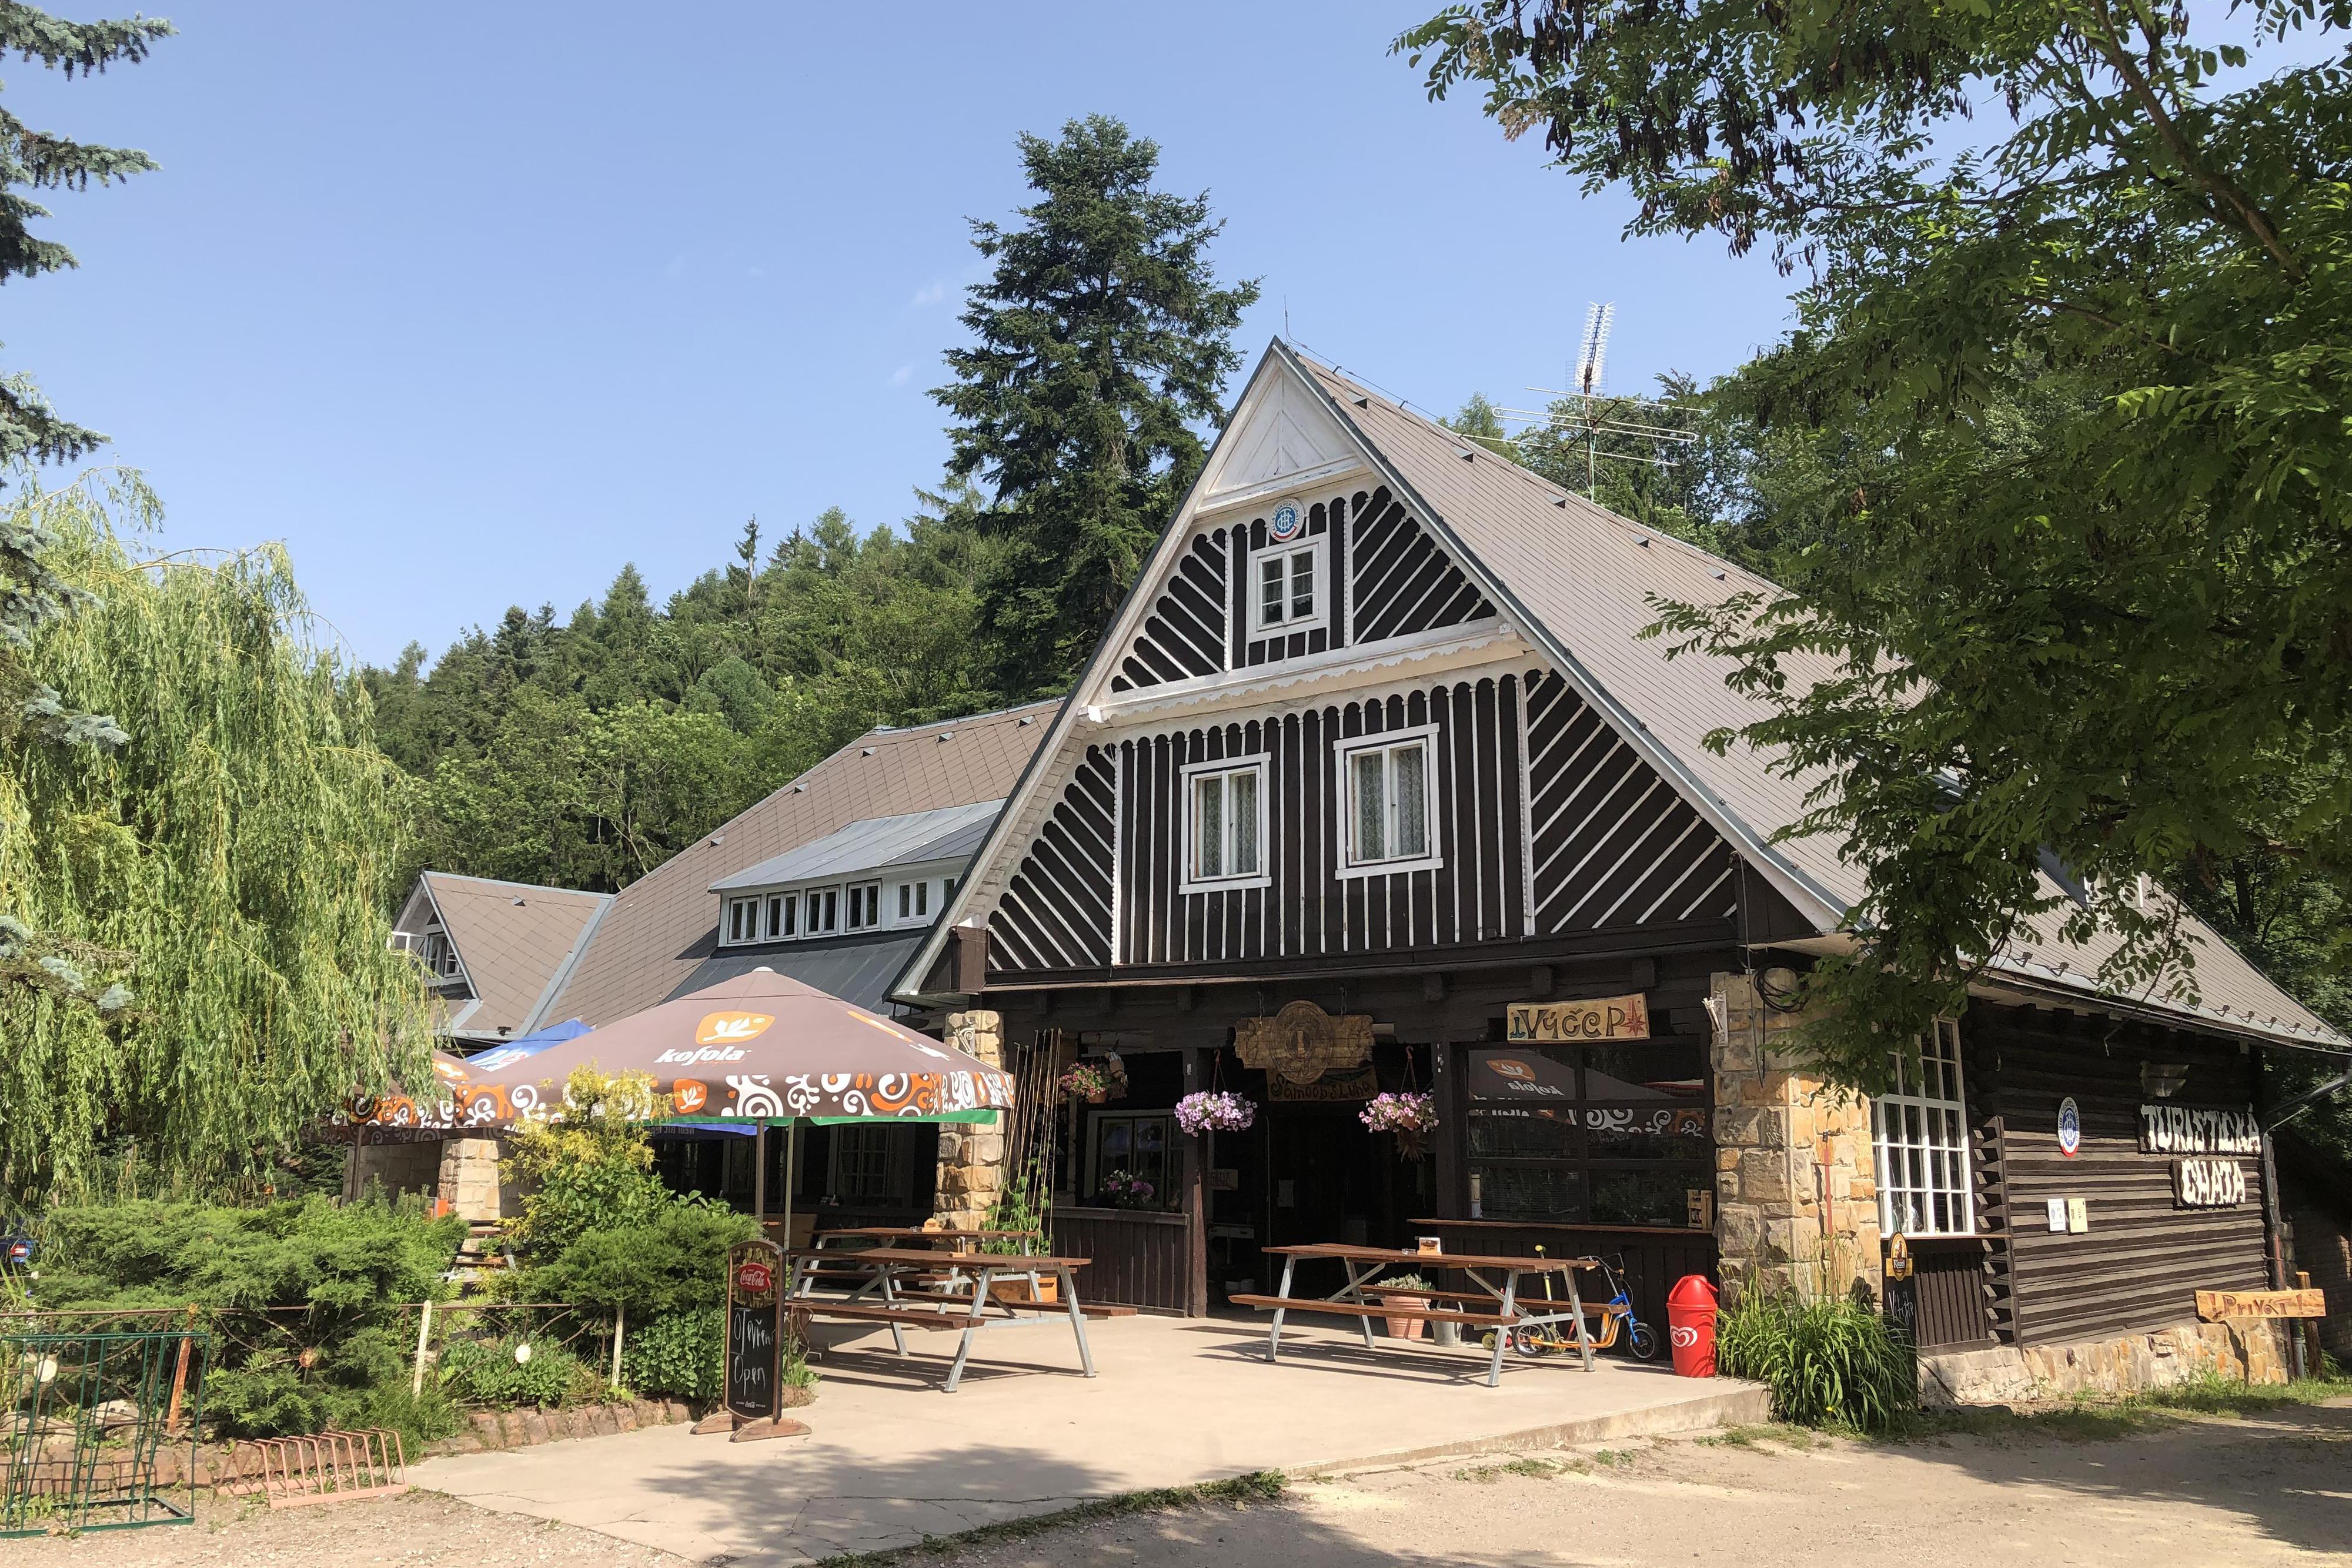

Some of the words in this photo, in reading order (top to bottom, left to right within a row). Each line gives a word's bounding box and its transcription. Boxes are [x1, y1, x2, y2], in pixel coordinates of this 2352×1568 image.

[654, 1045, 746, 1066] kofola
[2181, 1159, 2246, 1205] CHATA
[734, 1354, 766, 1397] Open
